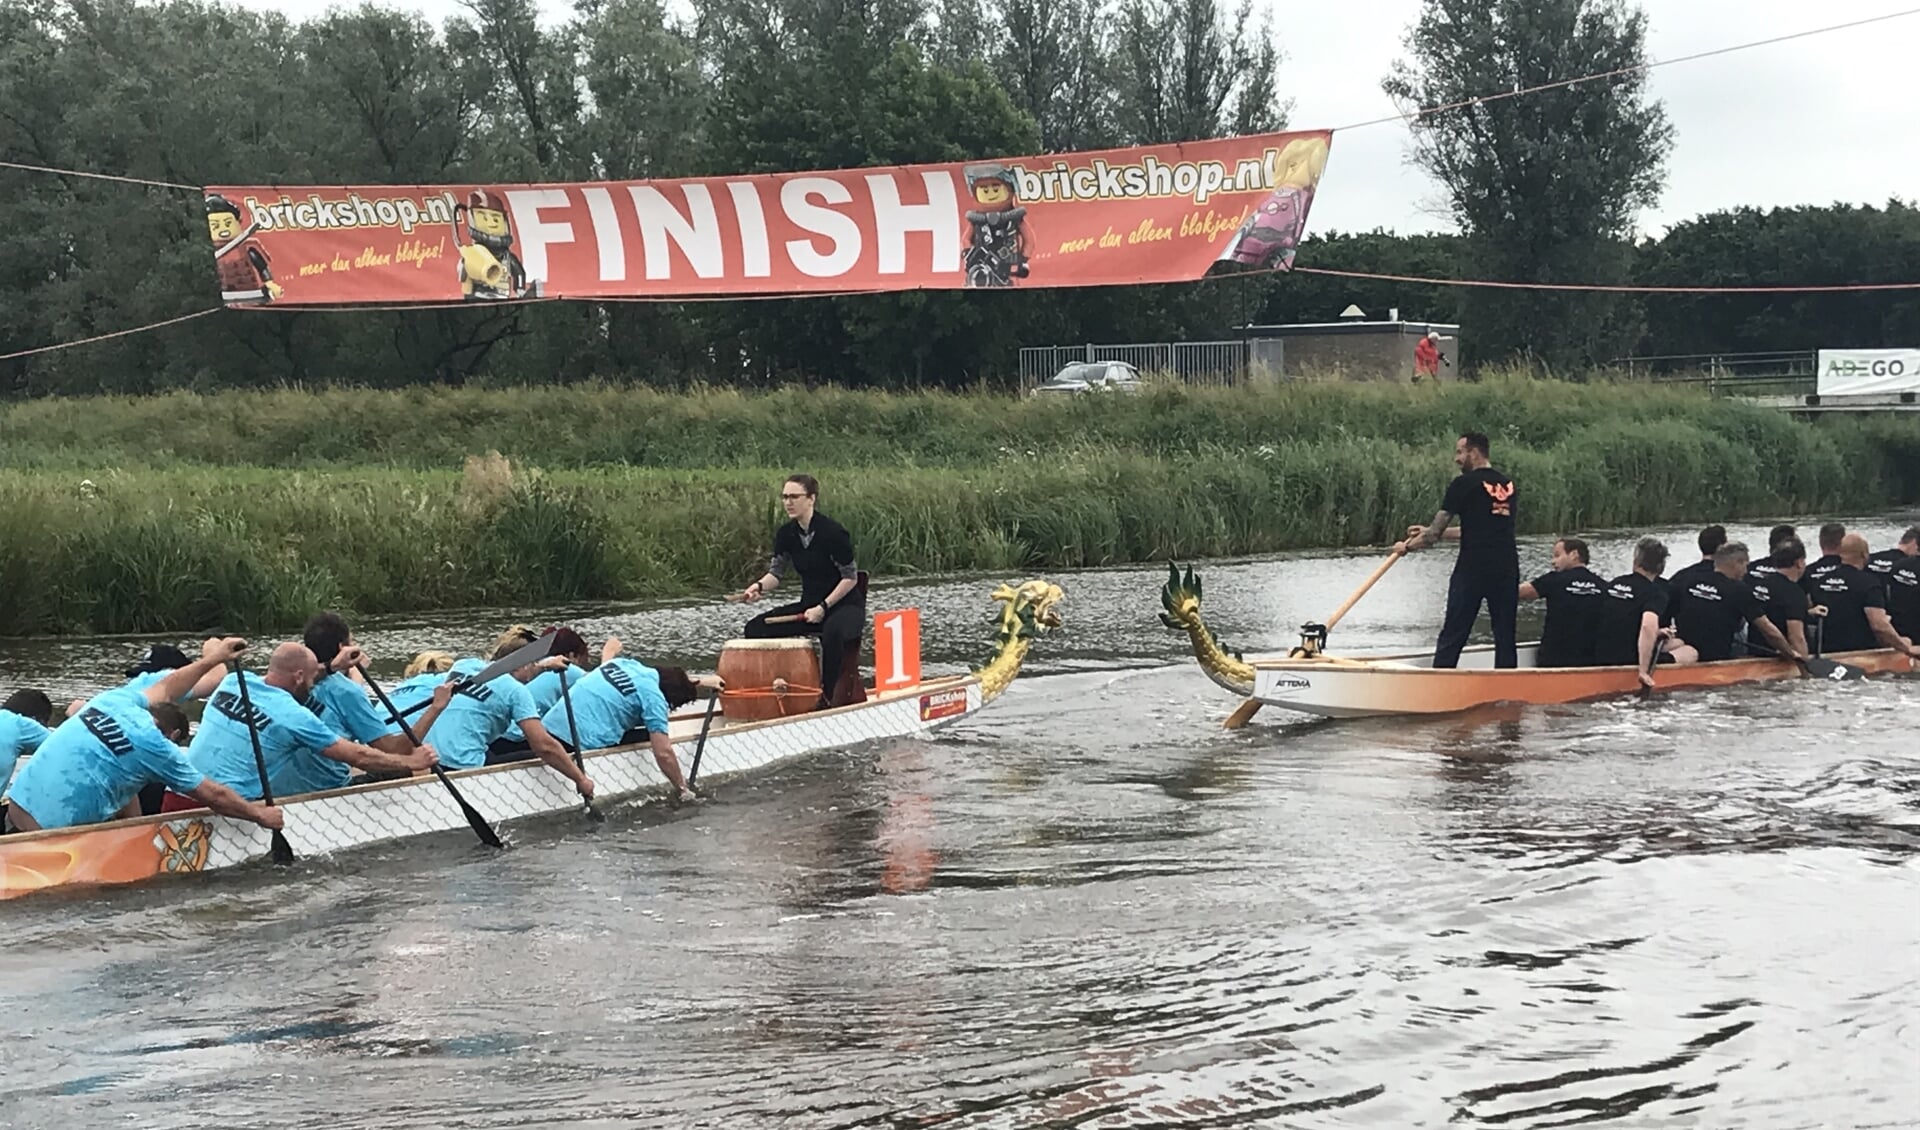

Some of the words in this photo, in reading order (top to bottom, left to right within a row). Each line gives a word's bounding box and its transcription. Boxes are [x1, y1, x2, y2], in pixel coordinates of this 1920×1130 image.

[1016, 150, 1276, 204] brickshop.nl
[246, 192, 463, 233] brickshop.nl
[504, 170, 961, 284] FINISH
[1058, 238, 1095, 255] meer
[1099, 226, 1123, 249] dan
[1128, 218, 1172, 245] alleen
[1180, 205, 1248, 242] blokjes!
[299, 263, 328, 277] meer
[331, 252, 351, 272] dan
[354, 246, 391, 269] alleen
[395, 236, 446, 269] blokjes!
[883, 613, 913, 685] 1
[1276, 680, 1311, 688] ATTEMA
